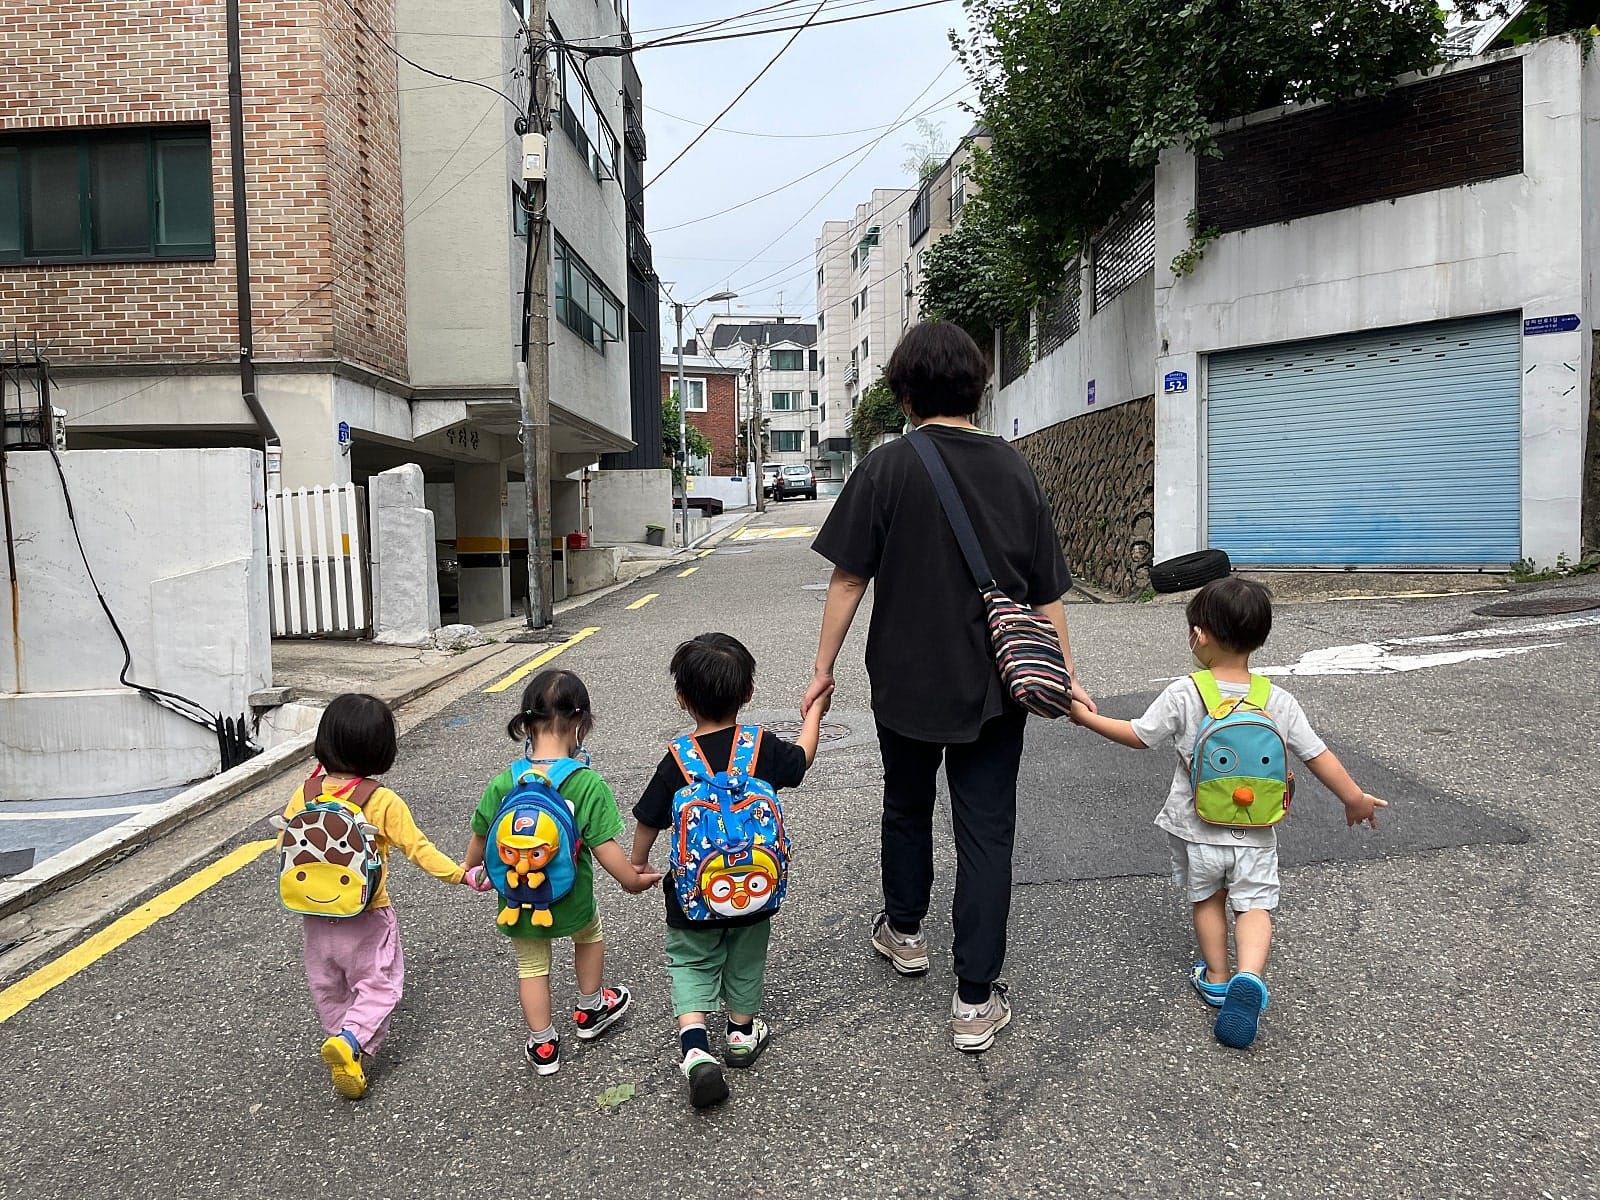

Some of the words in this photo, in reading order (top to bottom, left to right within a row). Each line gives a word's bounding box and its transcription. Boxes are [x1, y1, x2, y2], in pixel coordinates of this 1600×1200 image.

[1169, 381, 1185, 391] 52
[514, 816, 534, 832] P
[728, 850, 747, 866] P
